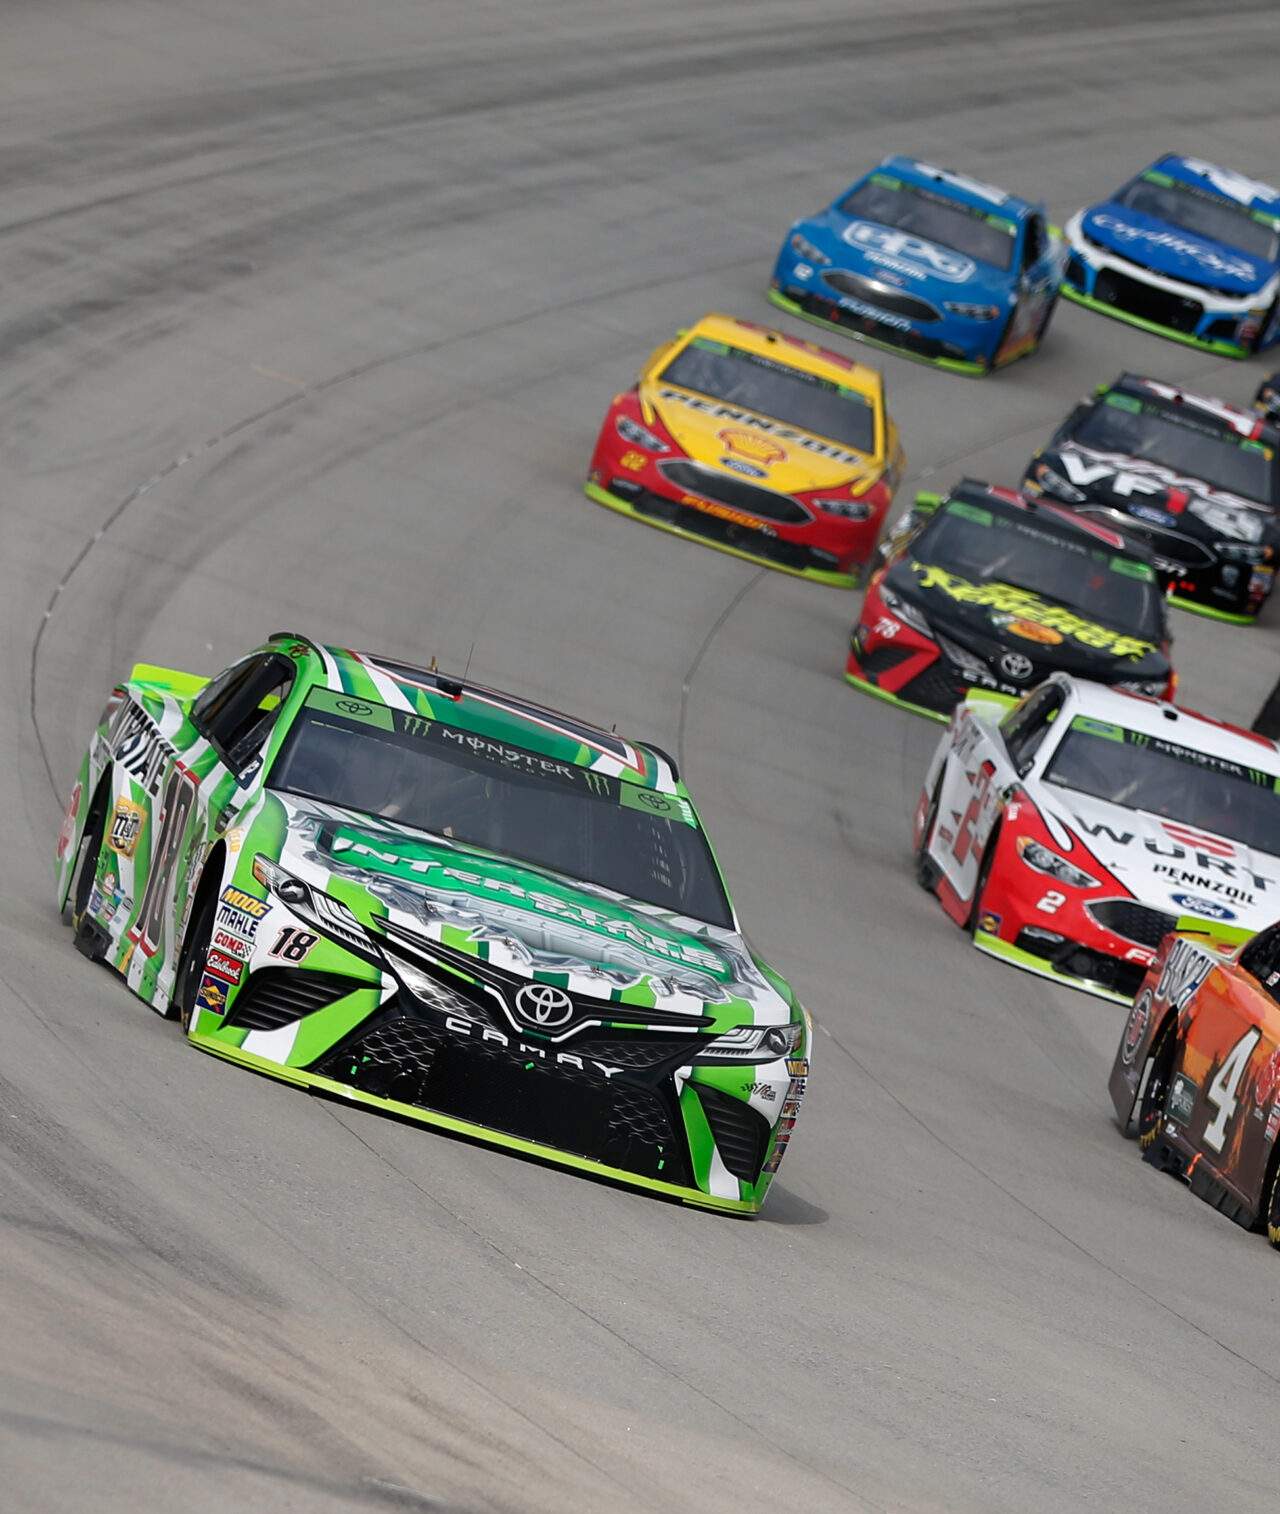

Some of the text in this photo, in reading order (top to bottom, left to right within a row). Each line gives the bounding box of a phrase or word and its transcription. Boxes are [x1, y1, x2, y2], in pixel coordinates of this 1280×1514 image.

[873, 617, 901, 639] 78
[441, 728, 575, 780] MONSTER
[1153, 863, 1257, 905] PENNZOIL
[221, 887, 269, 919] MOOG
[332, 836, 719, 966] INTERSTATE
[1036, 890, 1067, 914] 2
[1178, 896, 1225, 919] Ford
[216, 906, 259, 938] MAHLE
[214, 931, 244, 953] COMP
[268, 925, 321, 964] 18
[206, 954, 241, 983] Edelbrock
[199, 986, 226, 1006] SUNOCO
[445, 1015, 624, 1079] CAMRY
[1203, 1024, 1263, 1154] 4
